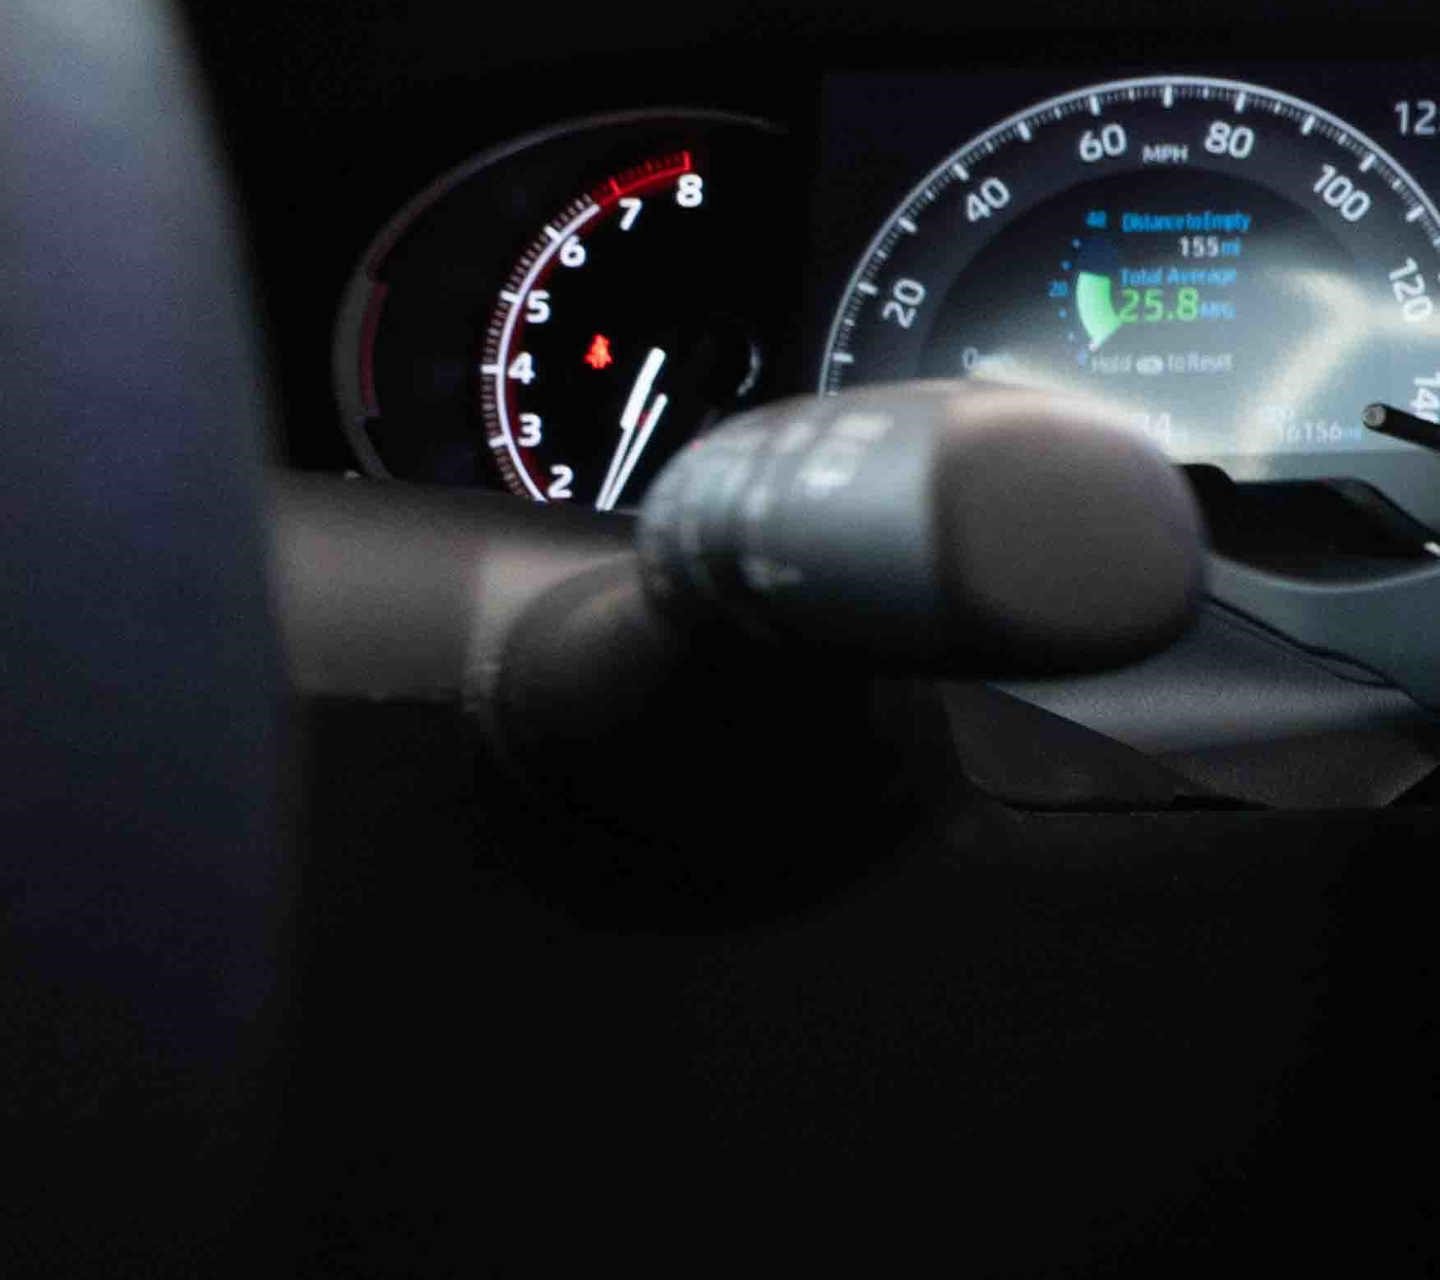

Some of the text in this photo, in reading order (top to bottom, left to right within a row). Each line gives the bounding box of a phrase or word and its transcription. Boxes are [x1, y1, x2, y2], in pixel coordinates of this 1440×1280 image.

[1079, 123, 1127, 163] 60
[1142, 144, 1188, 164] MPH
[1205, 121, 1255, 160] 80
[676, 174, 703, 208] 8
[964, 176, 1011, 223] 40
[1311, 162, 1371, 223] 100
[619, 198, 643, 231] 7
[559, 235, 586, 267] 6
[1179, 236, 1219, 257] 155
[882, 278, 926, 329] 20
[1119, 288, 1199, 322] 25.8
[1389, 257, 1433, 321] 120
[525, 290, 550, 323] 5
[508, 352, 536, 384] 4
[518, 414, 542, 448] 3
[549, 465, 573, 498] 2
